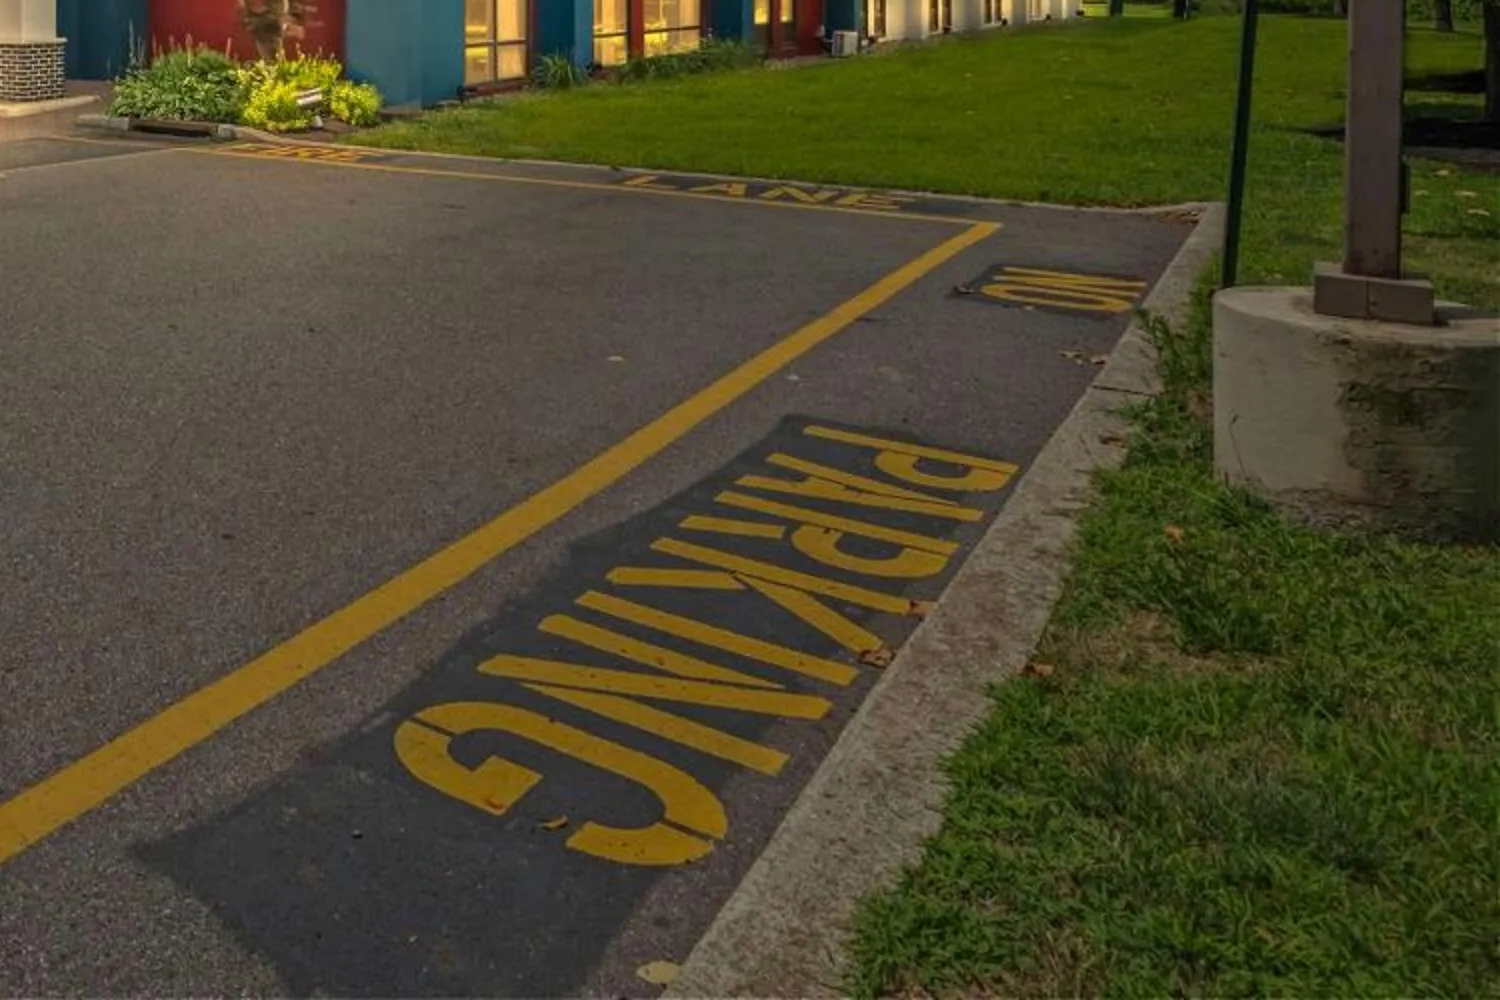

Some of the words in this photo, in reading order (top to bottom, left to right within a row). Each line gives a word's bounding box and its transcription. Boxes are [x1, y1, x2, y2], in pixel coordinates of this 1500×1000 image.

[623, 175, 916, 209] LANE
[980, 266, 1148, 313] NO
[393, 424, 1020, 866] PARKING
